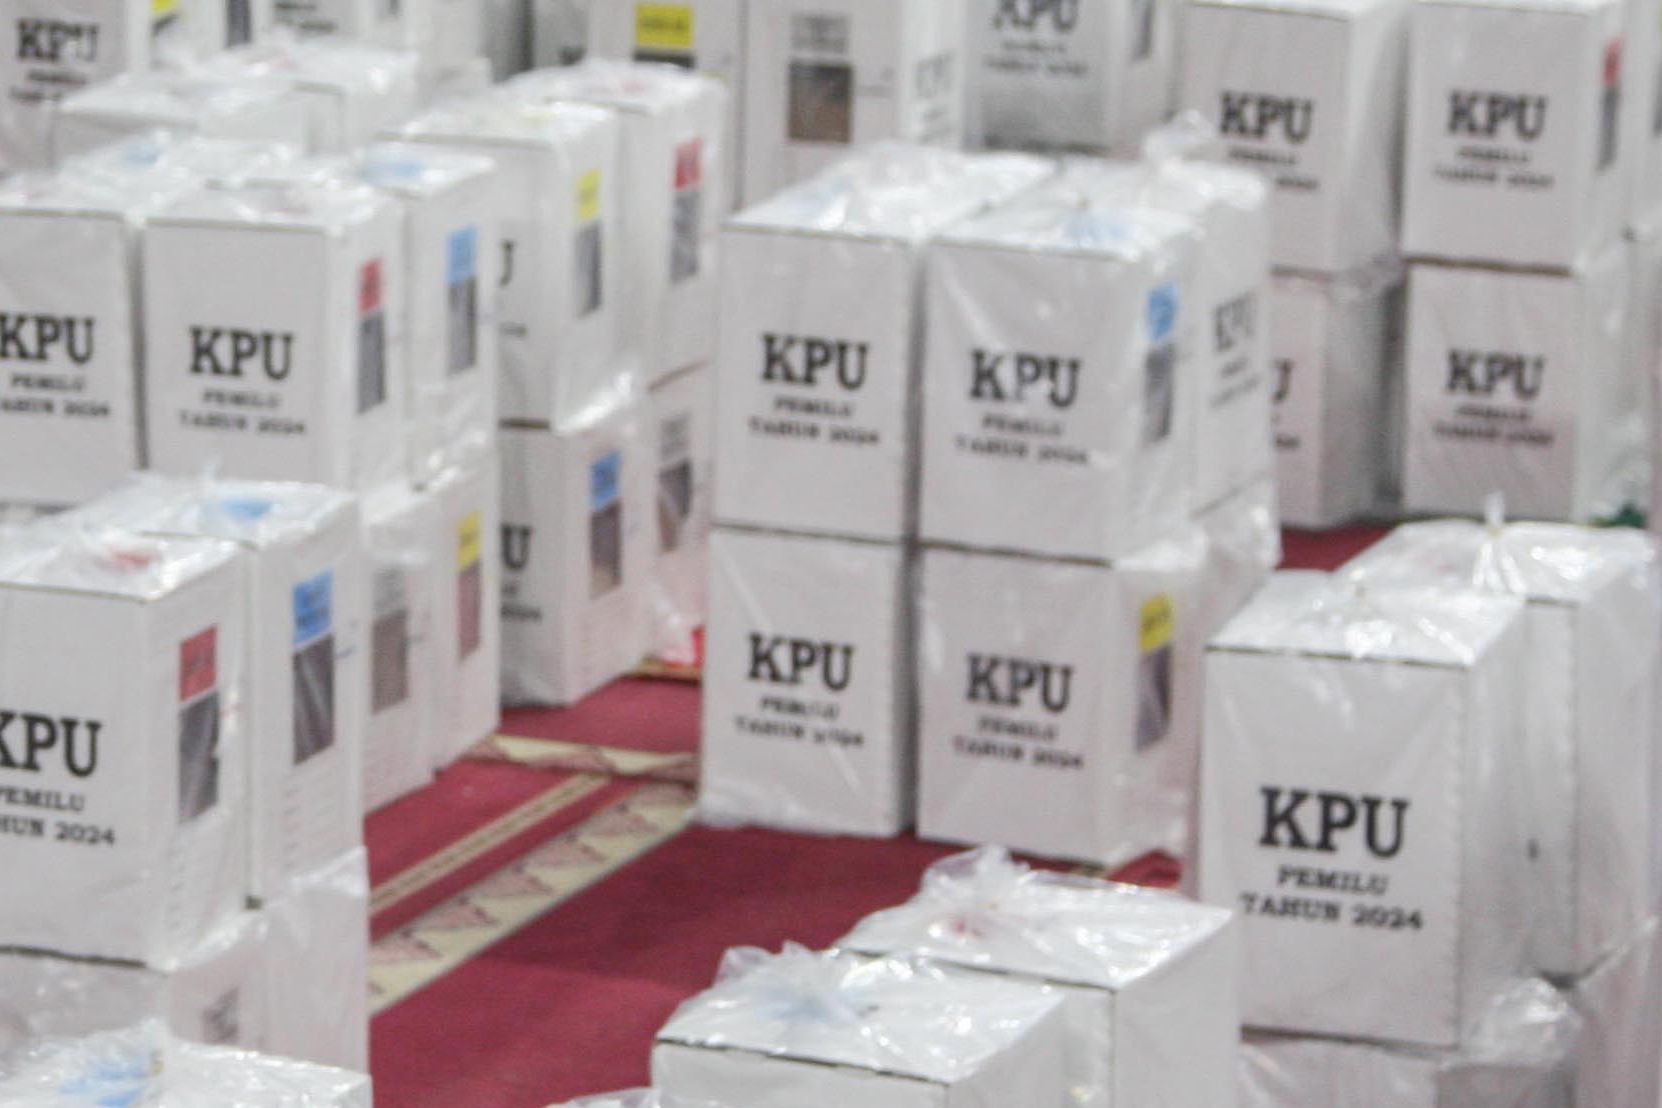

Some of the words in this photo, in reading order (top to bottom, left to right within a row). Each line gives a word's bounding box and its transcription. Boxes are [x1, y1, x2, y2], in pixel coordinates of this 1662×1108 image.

[1220, 91, 1315, 143] KPU
[1450, 89, 1547, 141] KPU
[188, 325, 295, 381] KPU
[763, 333, 868, 390] KPU
[970, 349, 1081, 408] KPU
[1446, 351, 1544, 400] KPU
[749, 633, 855, 691] KPU
[966, 654, 1074, 713] KPU
[56, 821, 115, 846] 2024
[1261, 786, 1411, 857] KPU
[1278, 864, 1388, 896] PEMILU
[1243, 894, 1341, 923] TAHUN
[1353, 903, 1424, 929] 2024
